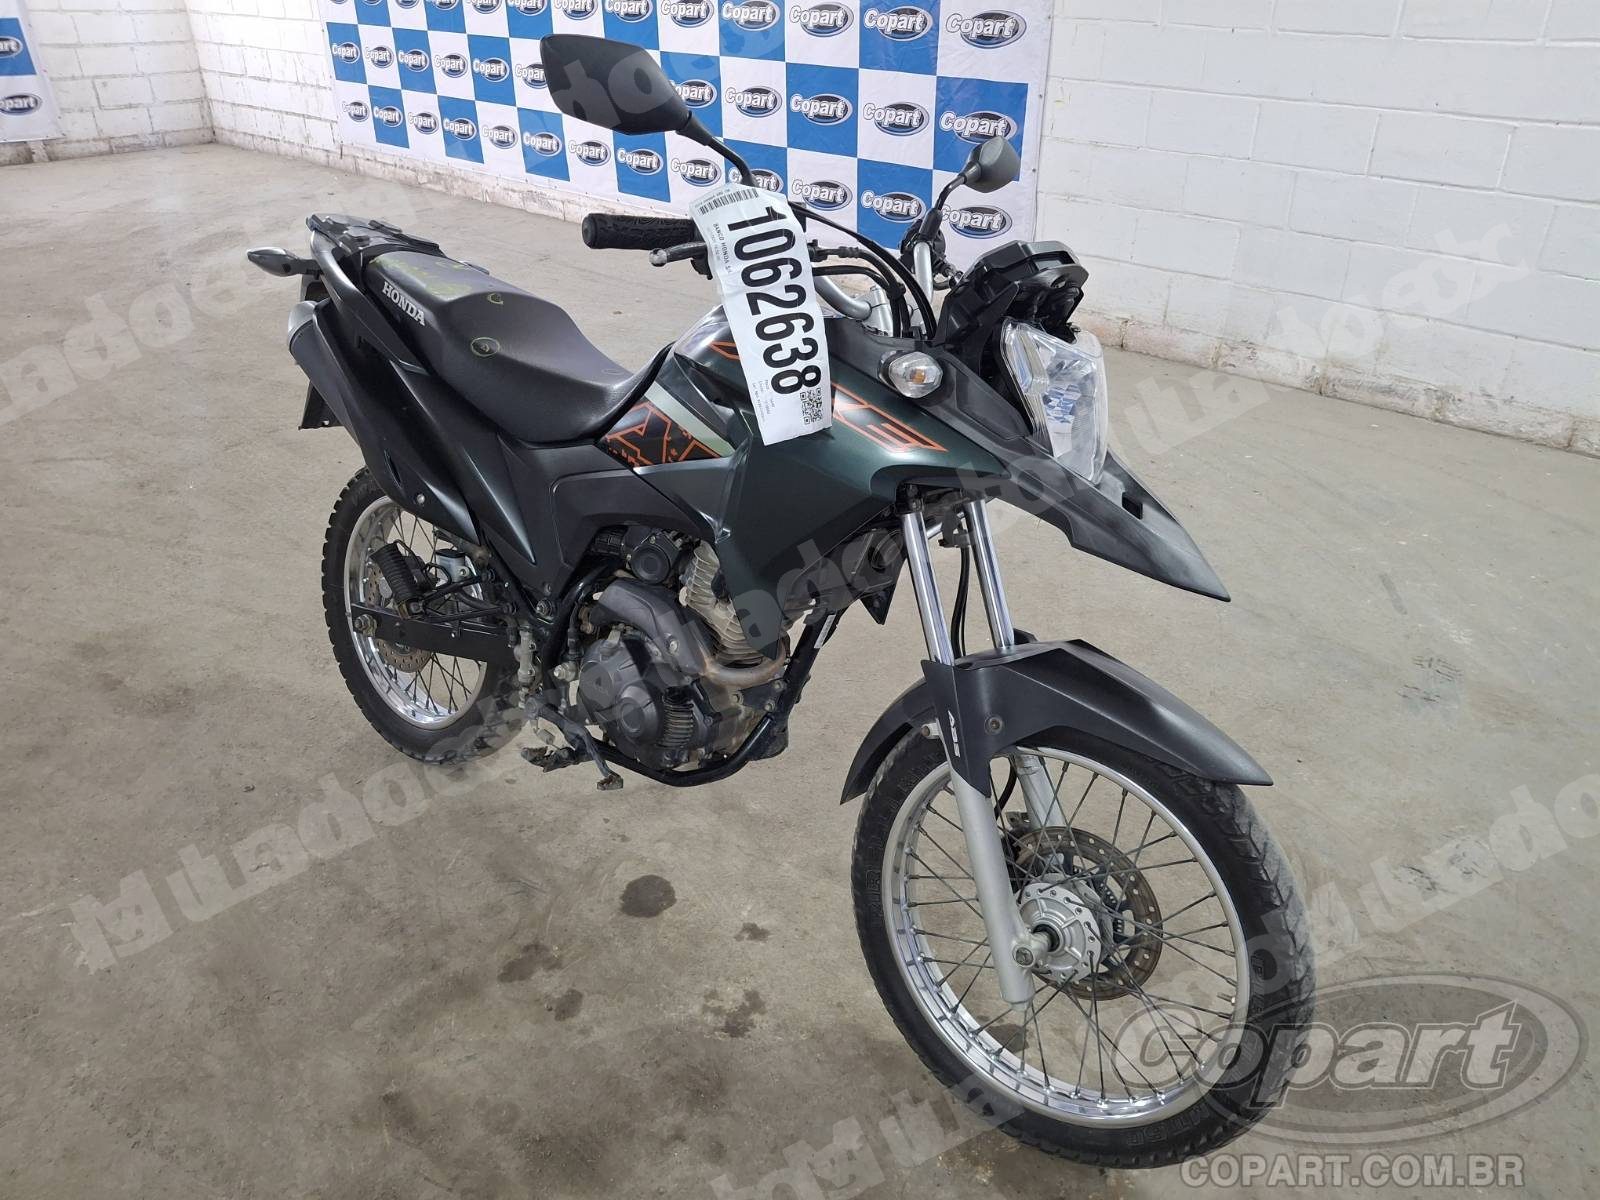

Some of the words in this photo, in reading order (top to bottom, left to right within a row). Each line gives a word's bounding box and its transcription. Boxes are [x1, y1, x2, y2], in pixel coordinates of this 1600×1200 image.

[605, 0, 648, 17] Copart
[660, 0, 707, 18] Copart
[722, 1, 776, 23] Copart
[790, 2, 845, 27] Copart
[864, 8, 928, 32] Copart
[946, 13, 1015, 38] Copart
[0, 97, 34, 110] opart
[332, 42, 358, 59] Copart
[366, 47, 391, 63] Copart
[399, 51, 427, 68] Copart
[434, 55, 465, 72] Copart
[473, 58, 505, 77] Copart
[515, 63, 546, 82] Copar
[725, 87, 778, 110] Copart
[790, 94, 849, 118] Copart
[863, 103, 921, 128] Copart
[940, 111, 1009, 137] Copart
[342, 101, 367, 117] Copart
[374, 107, 400, 124] Copart
[408, 112, 437, 130] Copart
[444, 118, 473, 136] Copart
[482, 125, 515, 142] Copart
[523, 131, 559, 150] Copart
[568, 140, 606, 160] Copart
[617, 148, 658, 168] Copart
[670, 158, 716, 180] Copart
[729, 167, 778, 192] Cart
[791, 179, 846, 205] Copart
[861, 191, 918, 217] Copart
[942, 204, 1003, 231] Copart
[713, 223, 725, 241] BANCO
[721, 242, 730, 265] HONDA
[382, 281, 426, 327] HONDA
[727, 206, 822, 395] 1062638
